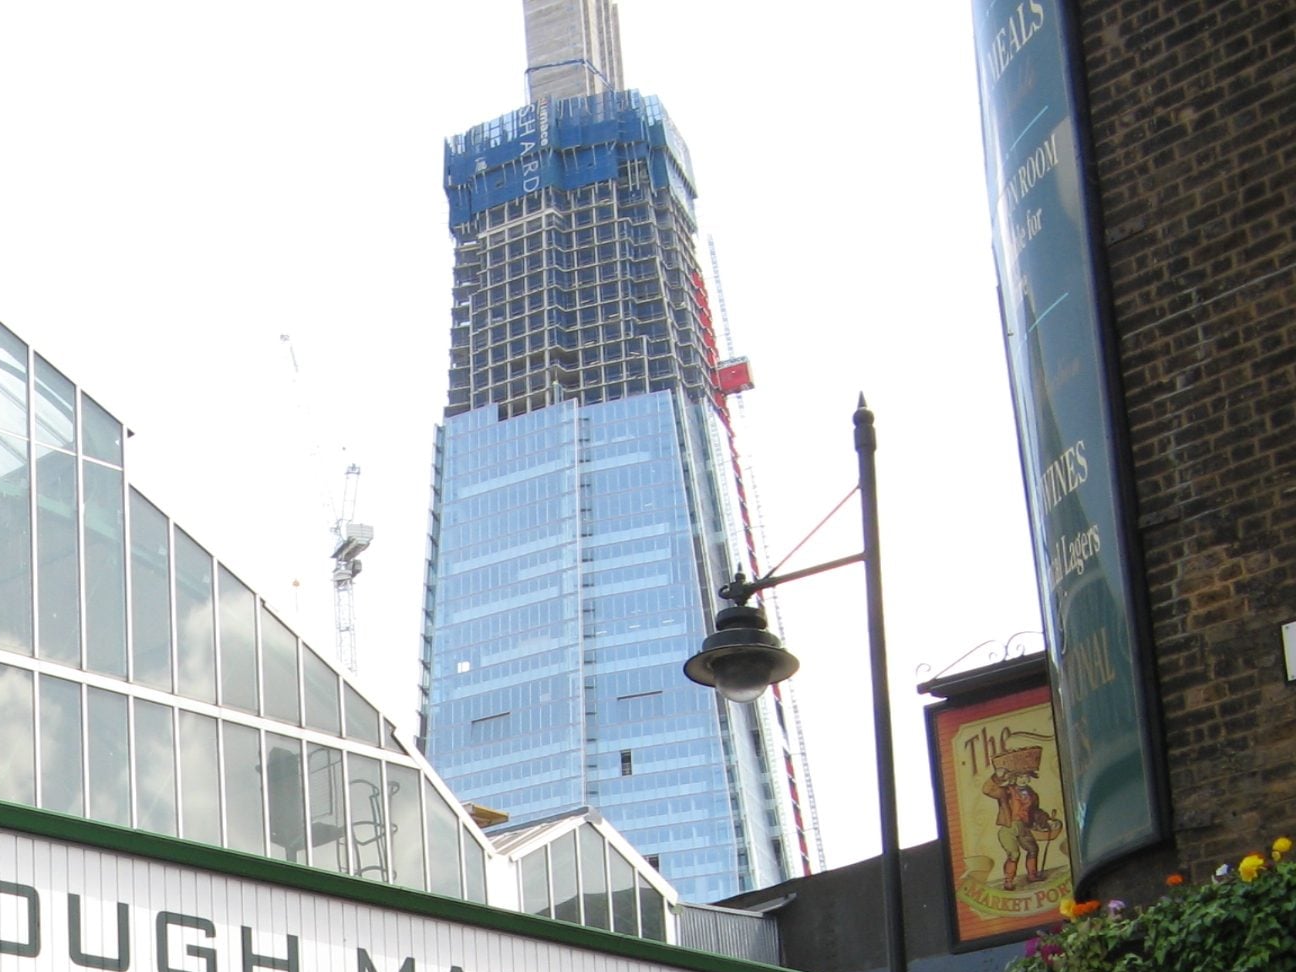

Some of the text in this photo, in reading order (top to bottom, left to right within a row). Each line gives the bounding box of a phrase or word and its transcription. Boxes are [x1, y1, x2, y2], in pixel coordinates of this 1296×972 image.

[519, 103, 540, 192] SHARD
[1018, 133, 1059, 197] ROOM
[1041, 440, 1088, 515] WINES
[1061, 524, 1101, 575] Lagers
[964, 726, 1014, 777] The
[965, 884, 1032, 912] MARKET
